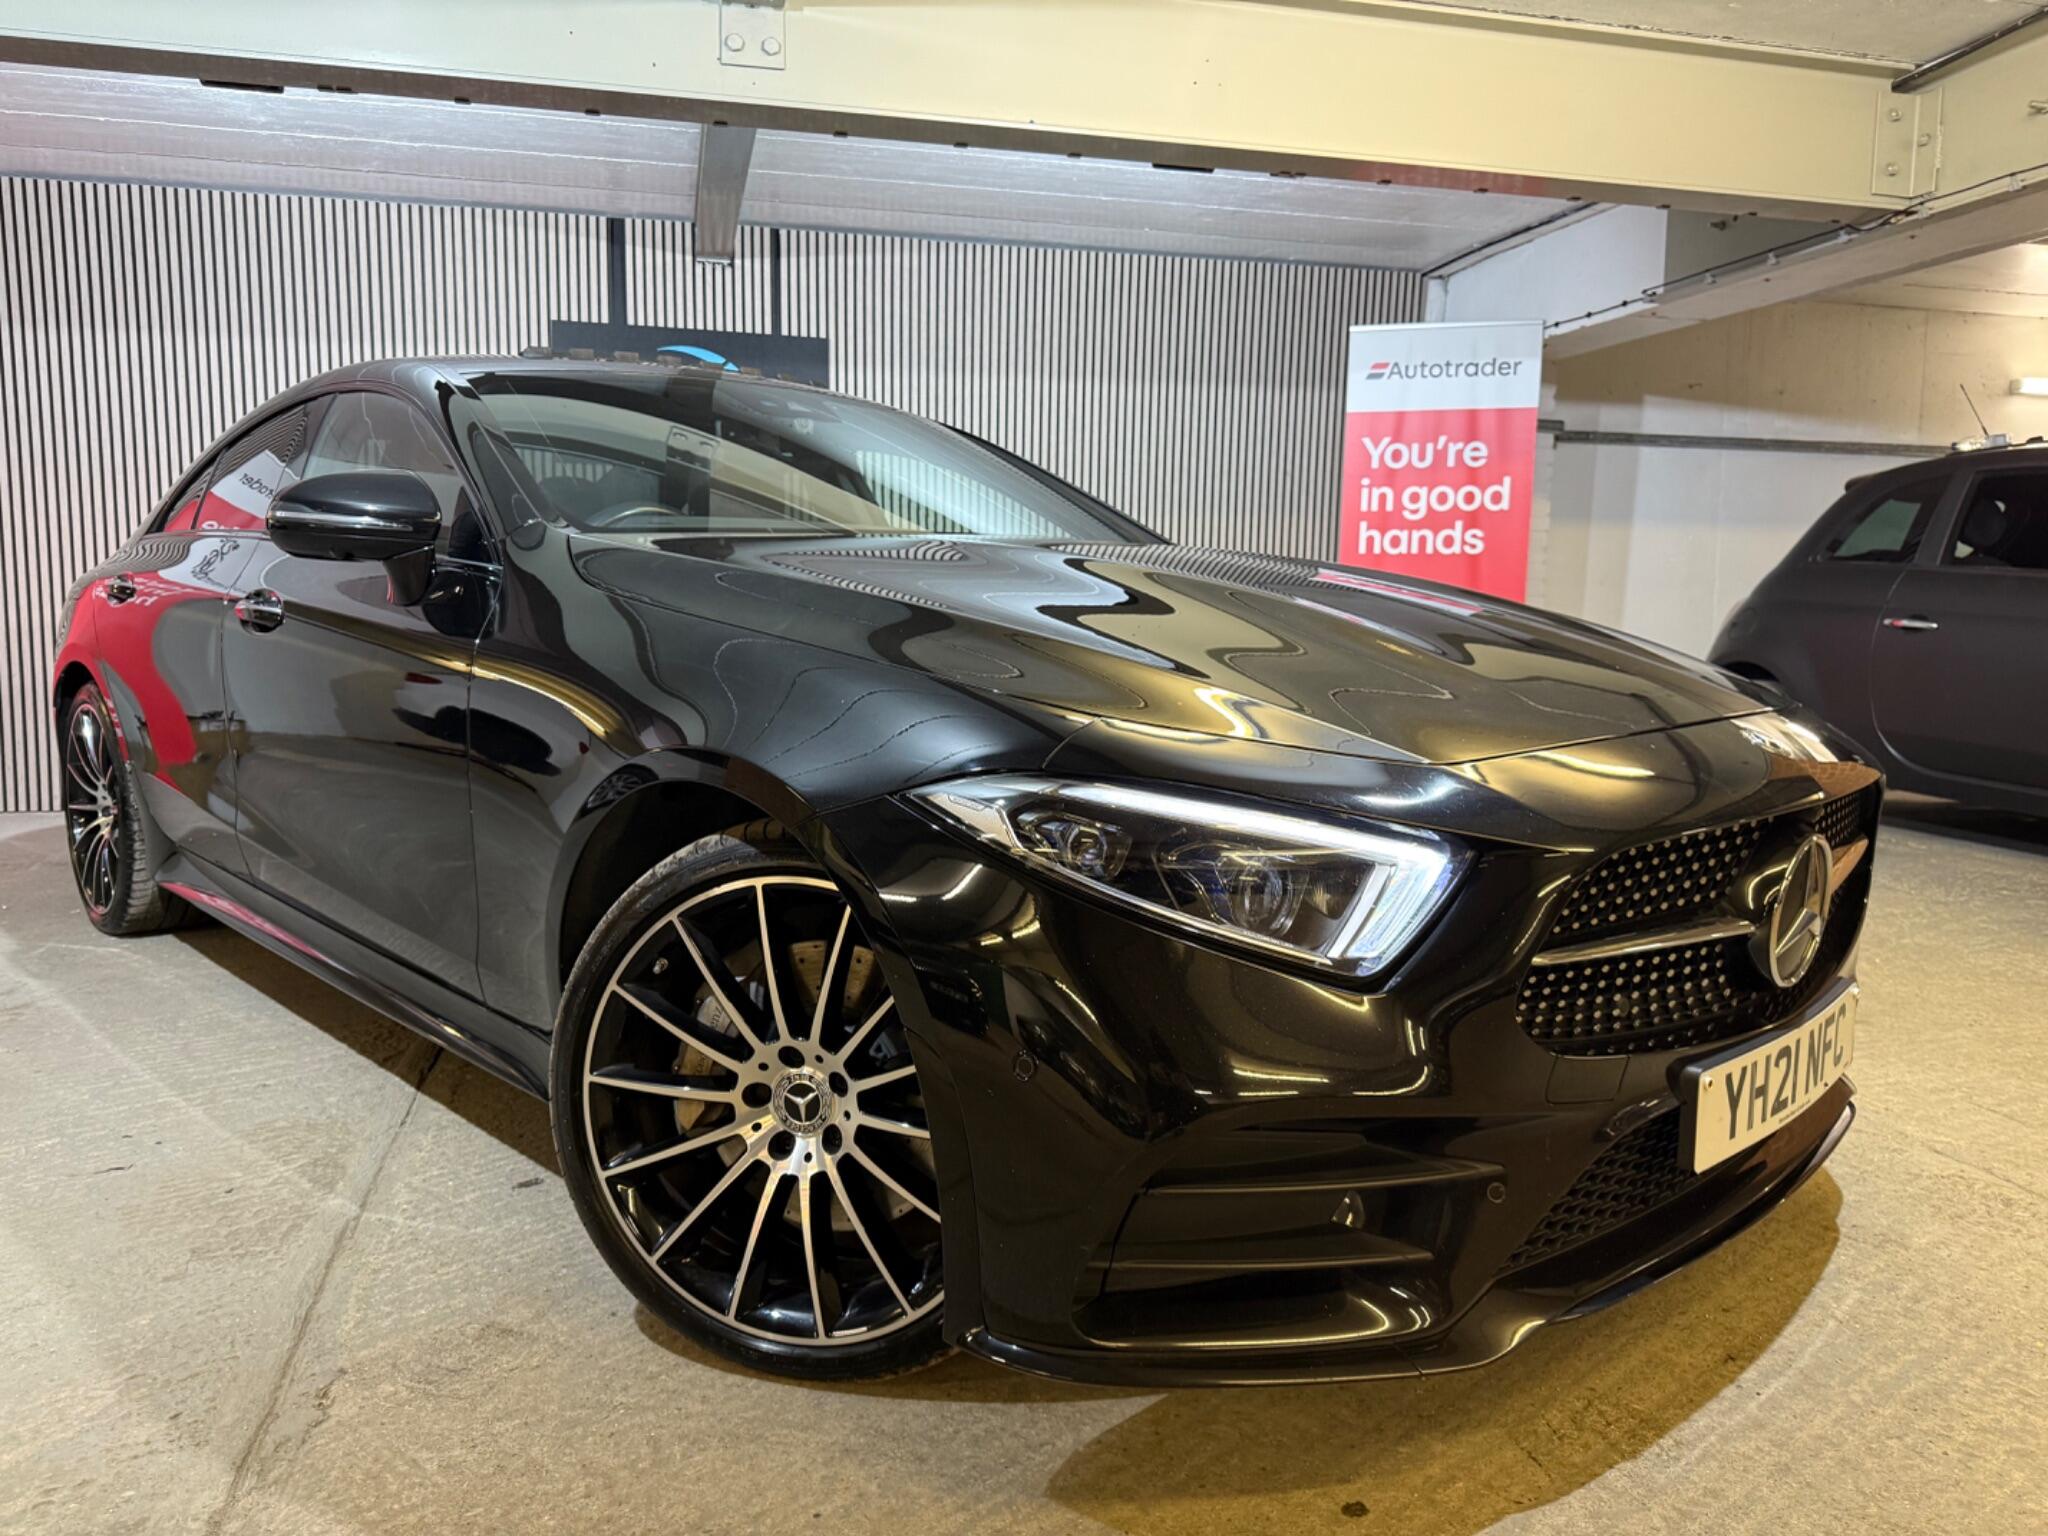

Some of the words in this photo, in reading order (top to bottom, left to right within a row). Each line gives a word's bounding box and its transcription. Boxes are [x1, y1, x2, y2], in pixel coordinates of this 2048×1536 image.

[1388, 357, 1522, 380] Autotrader
[1361, 435, 1488, 469] You’re
[1360, 477, 1394, 512] in
[1401, 476, 1511, 521] good
[1357, 520, 1485, 555] hands
[1725, 1037, 1801, 1140] YH21
[1805, 1002, 1846, 1095] NFC
